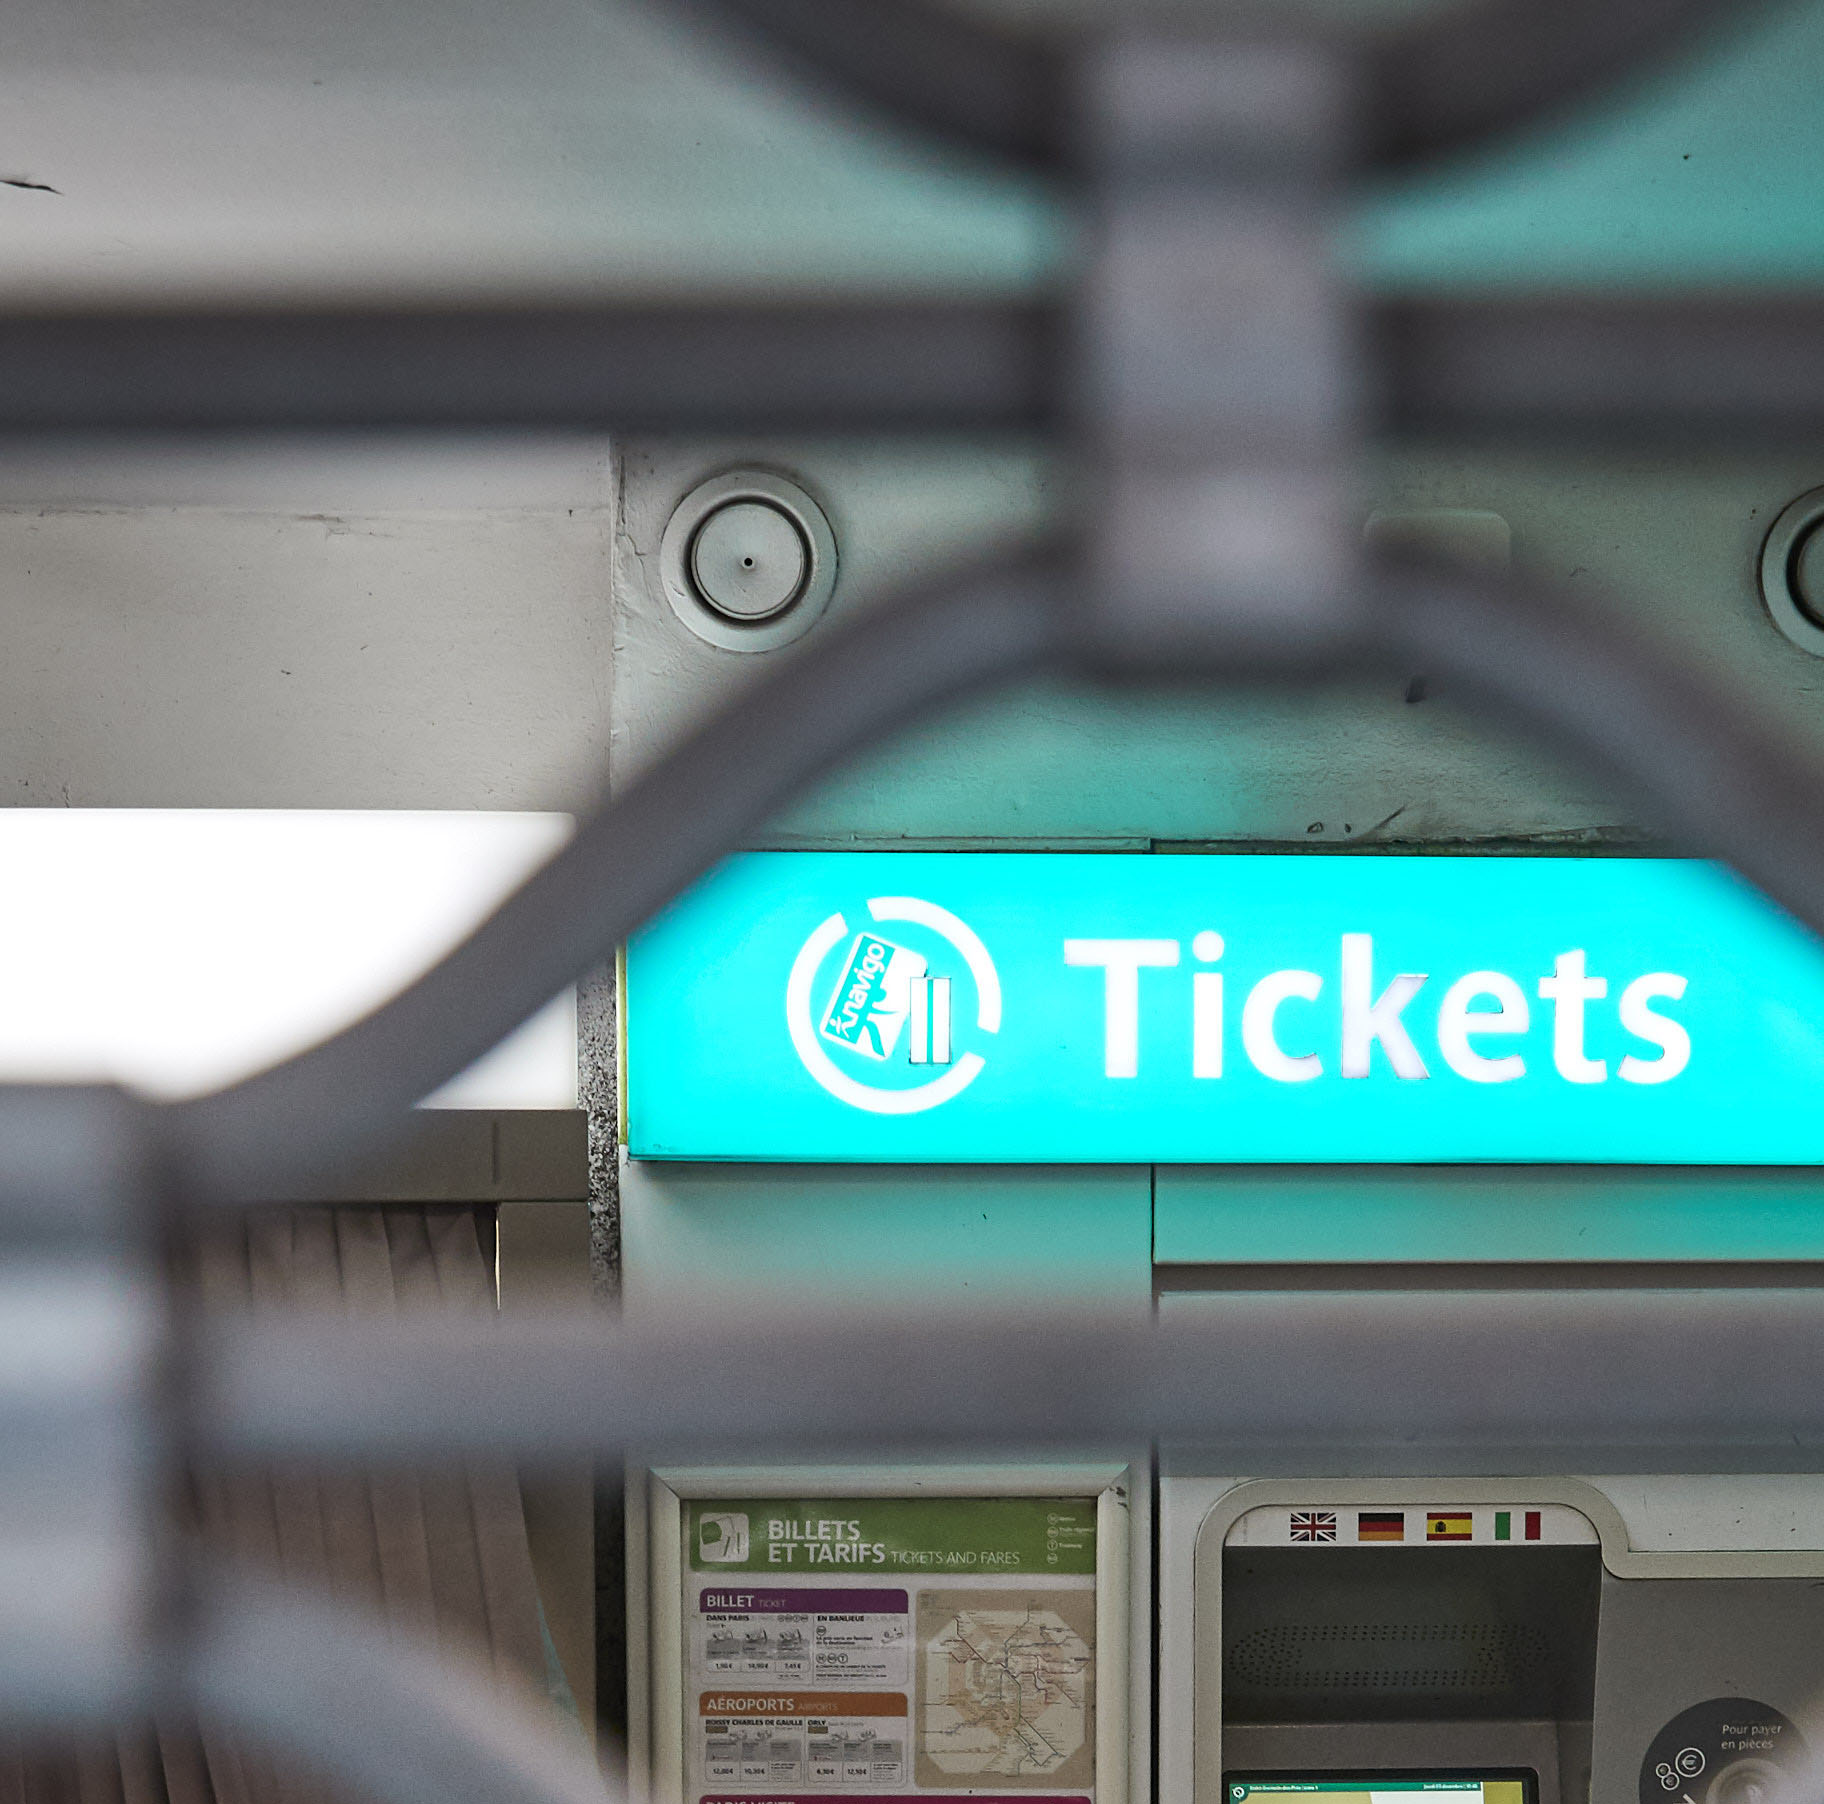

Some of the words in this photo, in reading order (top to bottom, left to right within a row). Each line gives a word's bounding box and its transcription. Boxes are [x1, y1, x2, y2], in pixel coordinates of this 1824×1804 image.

[1063, 929, 1692, 1084] Tickets
[767, 1520, 861, 1541] BILLETS
[768, 1543, 799, 1563] ET
[804, 1542, 886, 1564] TARIFS
[891, 1551, 944, 1564] TICKETS
[945, 1551, 977, 1564] AND
[980, 1551, 1021, 1565] FARES
[706, 1595, 755, 1608] BILLET
[707, 1696, 795, 1711] AÉROPORTS
[1722, 1724, 1748, 1735] Pour
[1751, 1725, 1783, 1737] payer
[1721, 1741, 1736, 1750] en
[1738, 1739, 1774, 1751] pièces
